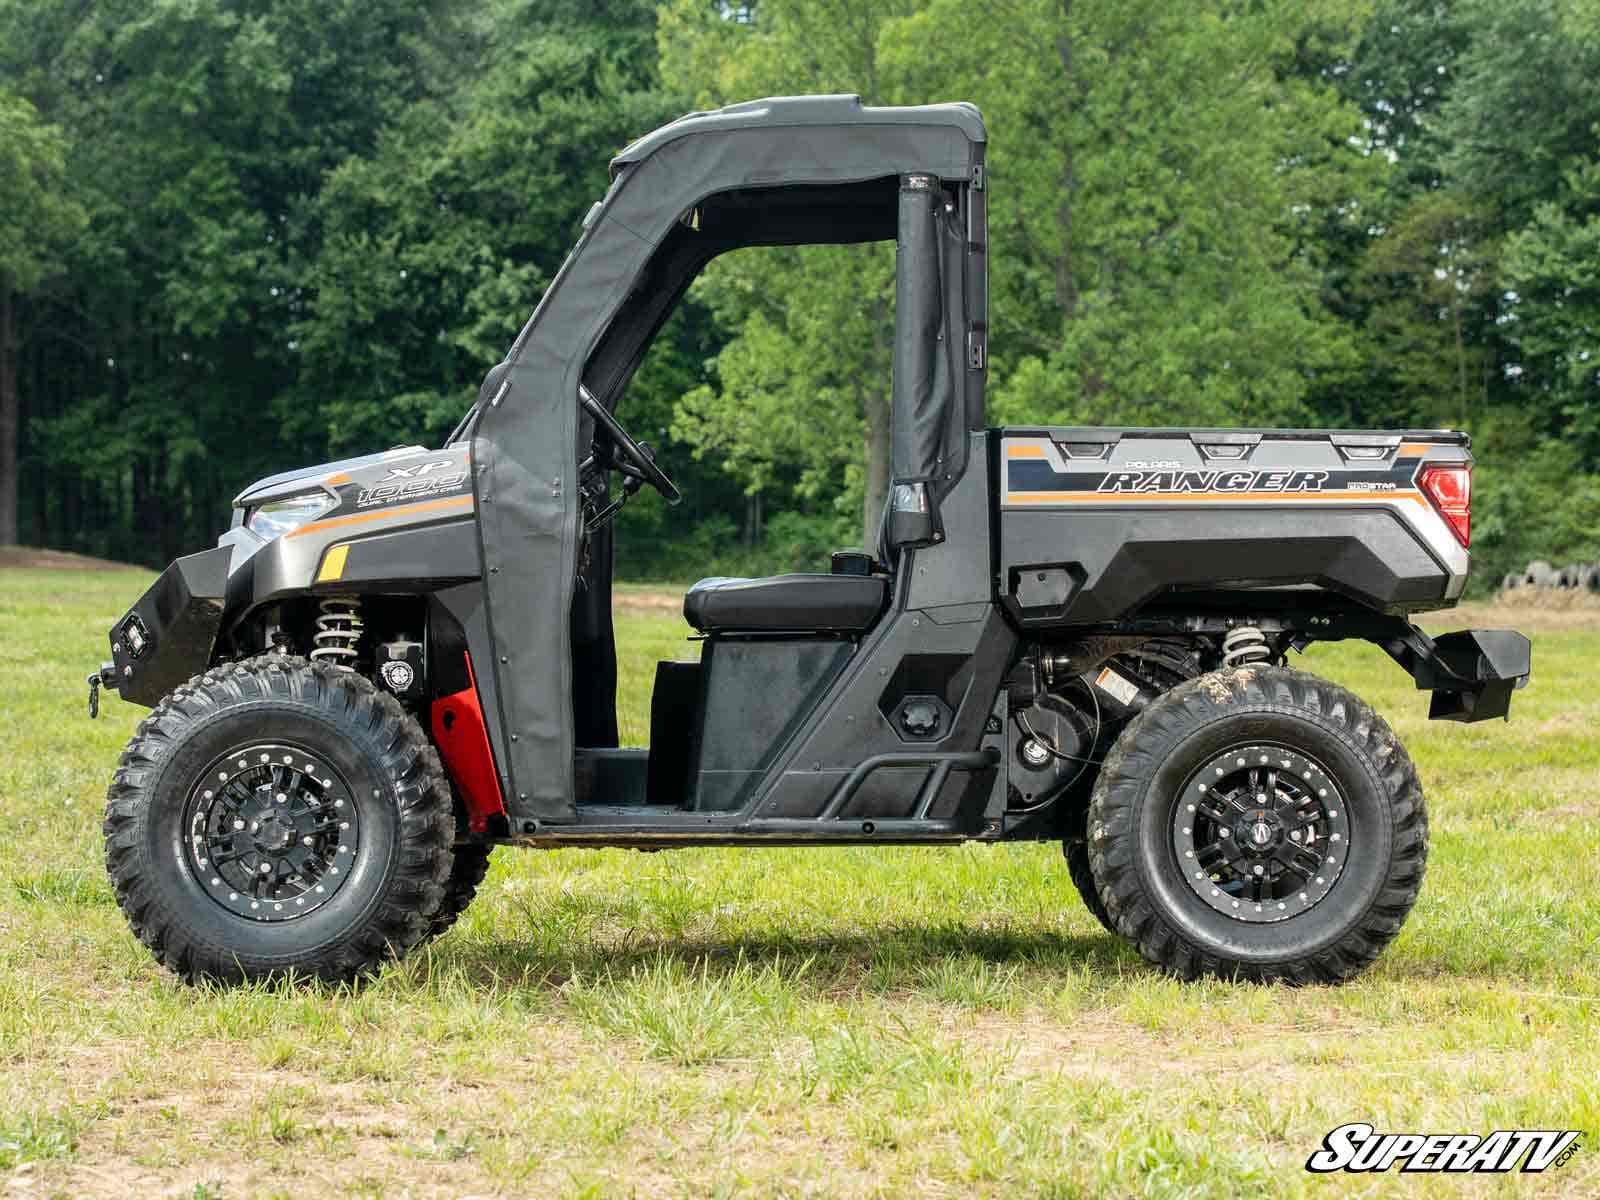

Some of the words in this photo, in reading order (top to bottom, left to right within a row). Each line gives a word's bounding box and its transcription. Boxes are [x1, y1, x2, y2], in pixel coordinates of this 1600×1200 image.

[377, 460, 453, 482] XP
[1125, 461, 1181, 469] POLARIS
[357, 471, 466, 503] 1000
[1096, 471, 1329, 492] RANGER
